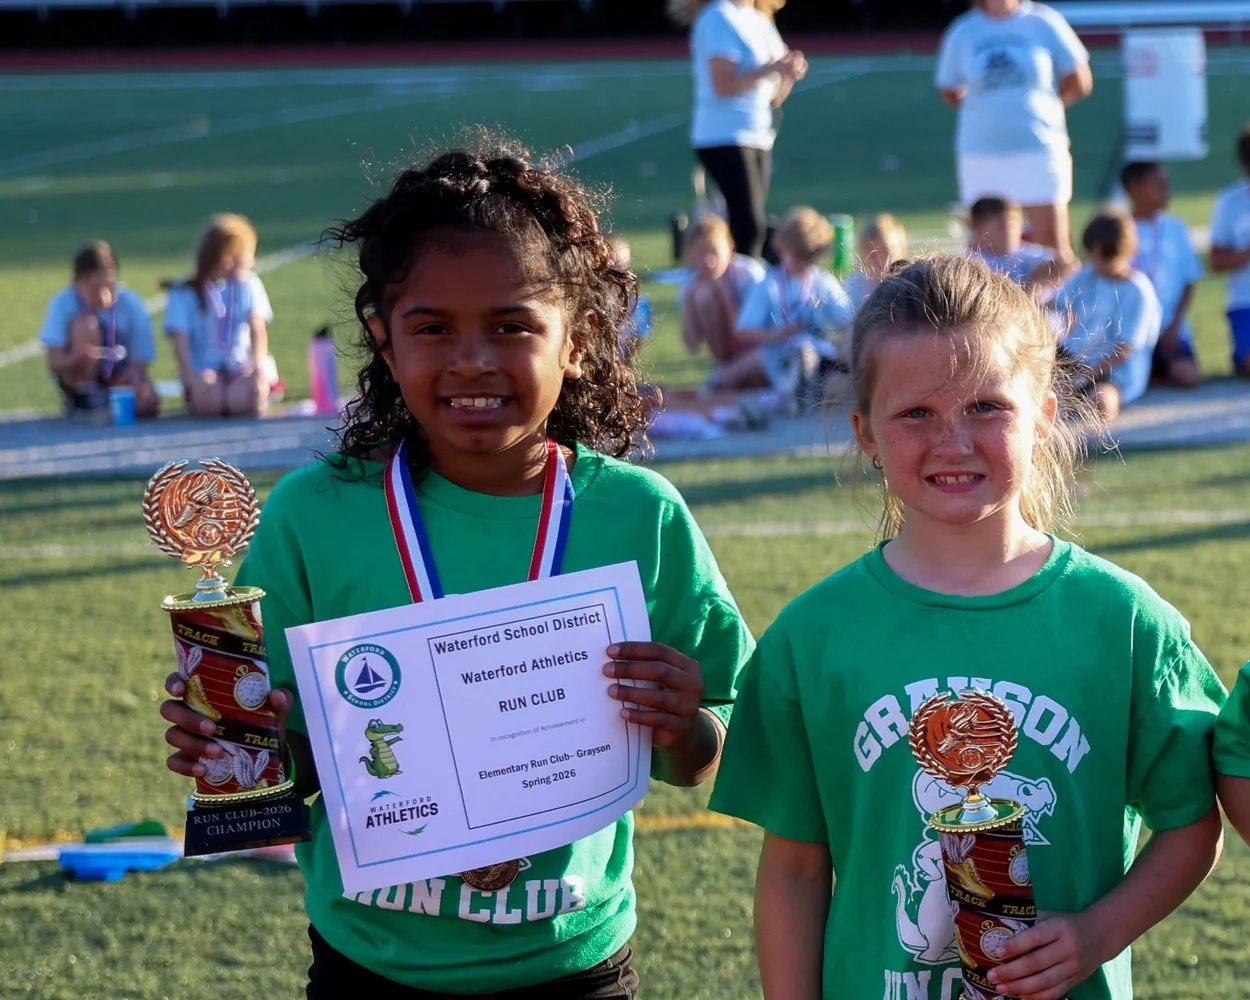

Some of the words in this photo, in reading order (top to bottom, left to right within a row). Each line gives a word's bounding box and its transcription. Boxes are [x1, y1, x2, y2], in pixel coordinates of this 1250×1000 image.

[178, 623, 220, 647] TRACK
[434, 631, 501, 655] Waterford
[504, 621, 549, 641] School
[552, 611, 602, 631] District
[242, 642, 266, 656] TRA
[341, 646, 386, 663] WATERFORD
[461, 662, 528, 685] Waterford
[531, 650, 589, 671] Athletics
[498, 696, 528, 713] RUN
[531, 688, 566, 706] CLUB
[479, 763, 529, 780] Elementary
[530, 758, 549, 769] Run
[576, 744, 611, 758] Grayson
[522, 775, 552, 789] Spring
[553, 769, 577, 782] 2026
[194, 813, 220, 825] RUN
[225, 805, 292, 820] CLUB-2026
[366, 802, 439, 829] ATHLETICS
[370, 796, 432, 813] WATERFORD
[207, 818, 281, 836] CHAMPION
[458, 875, 585, 924] CLUB
[950, 885, 986, 908] TRACK
[1002, 904, 1036, 917] TRACK
[966, 970, 997, 989] TRA
